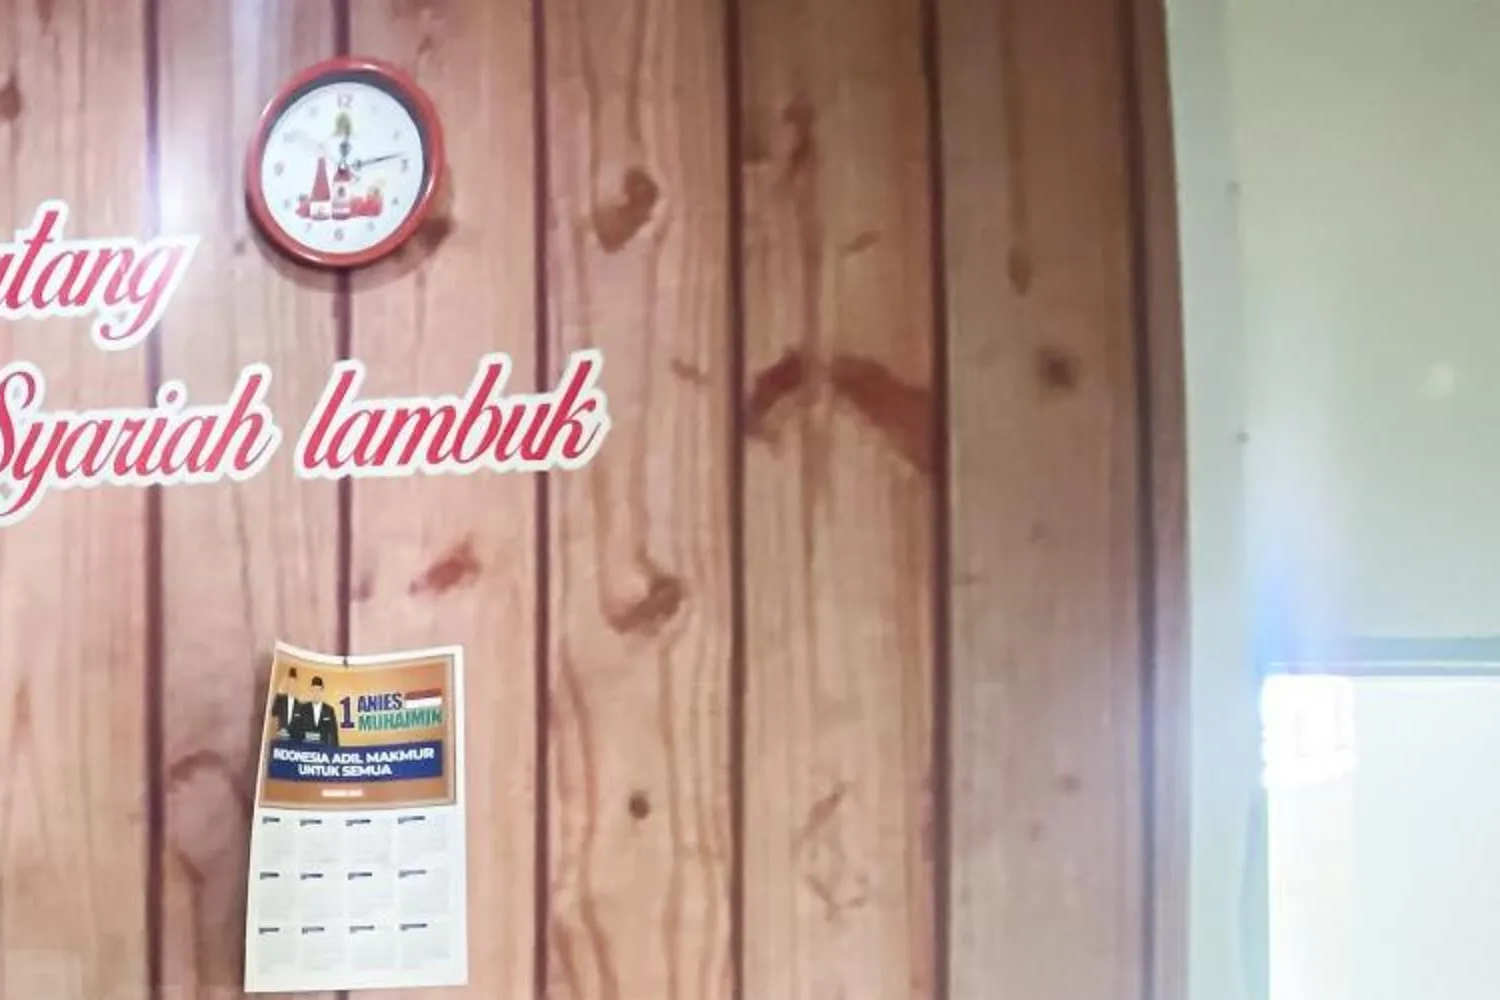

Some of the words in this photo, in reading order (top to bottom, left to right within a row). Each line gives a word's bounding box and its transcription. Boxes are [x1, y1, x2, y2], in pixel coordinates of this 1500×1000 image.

[303, 360, 600, 468] lambuk
[340, 696, 355, 728] 1
[357, 693, 402, 713] ANIES
[358, 707, 443, 732] MUHAIMIN
[273, 748, 330, 764] INDONESIA
[332, 752, 363, 764] ADIL
[366, 747, 435, 763] MAKMUR
[298, 764, 340, 776] UNTUK
[342, 764, 392, 776] SEMUA
